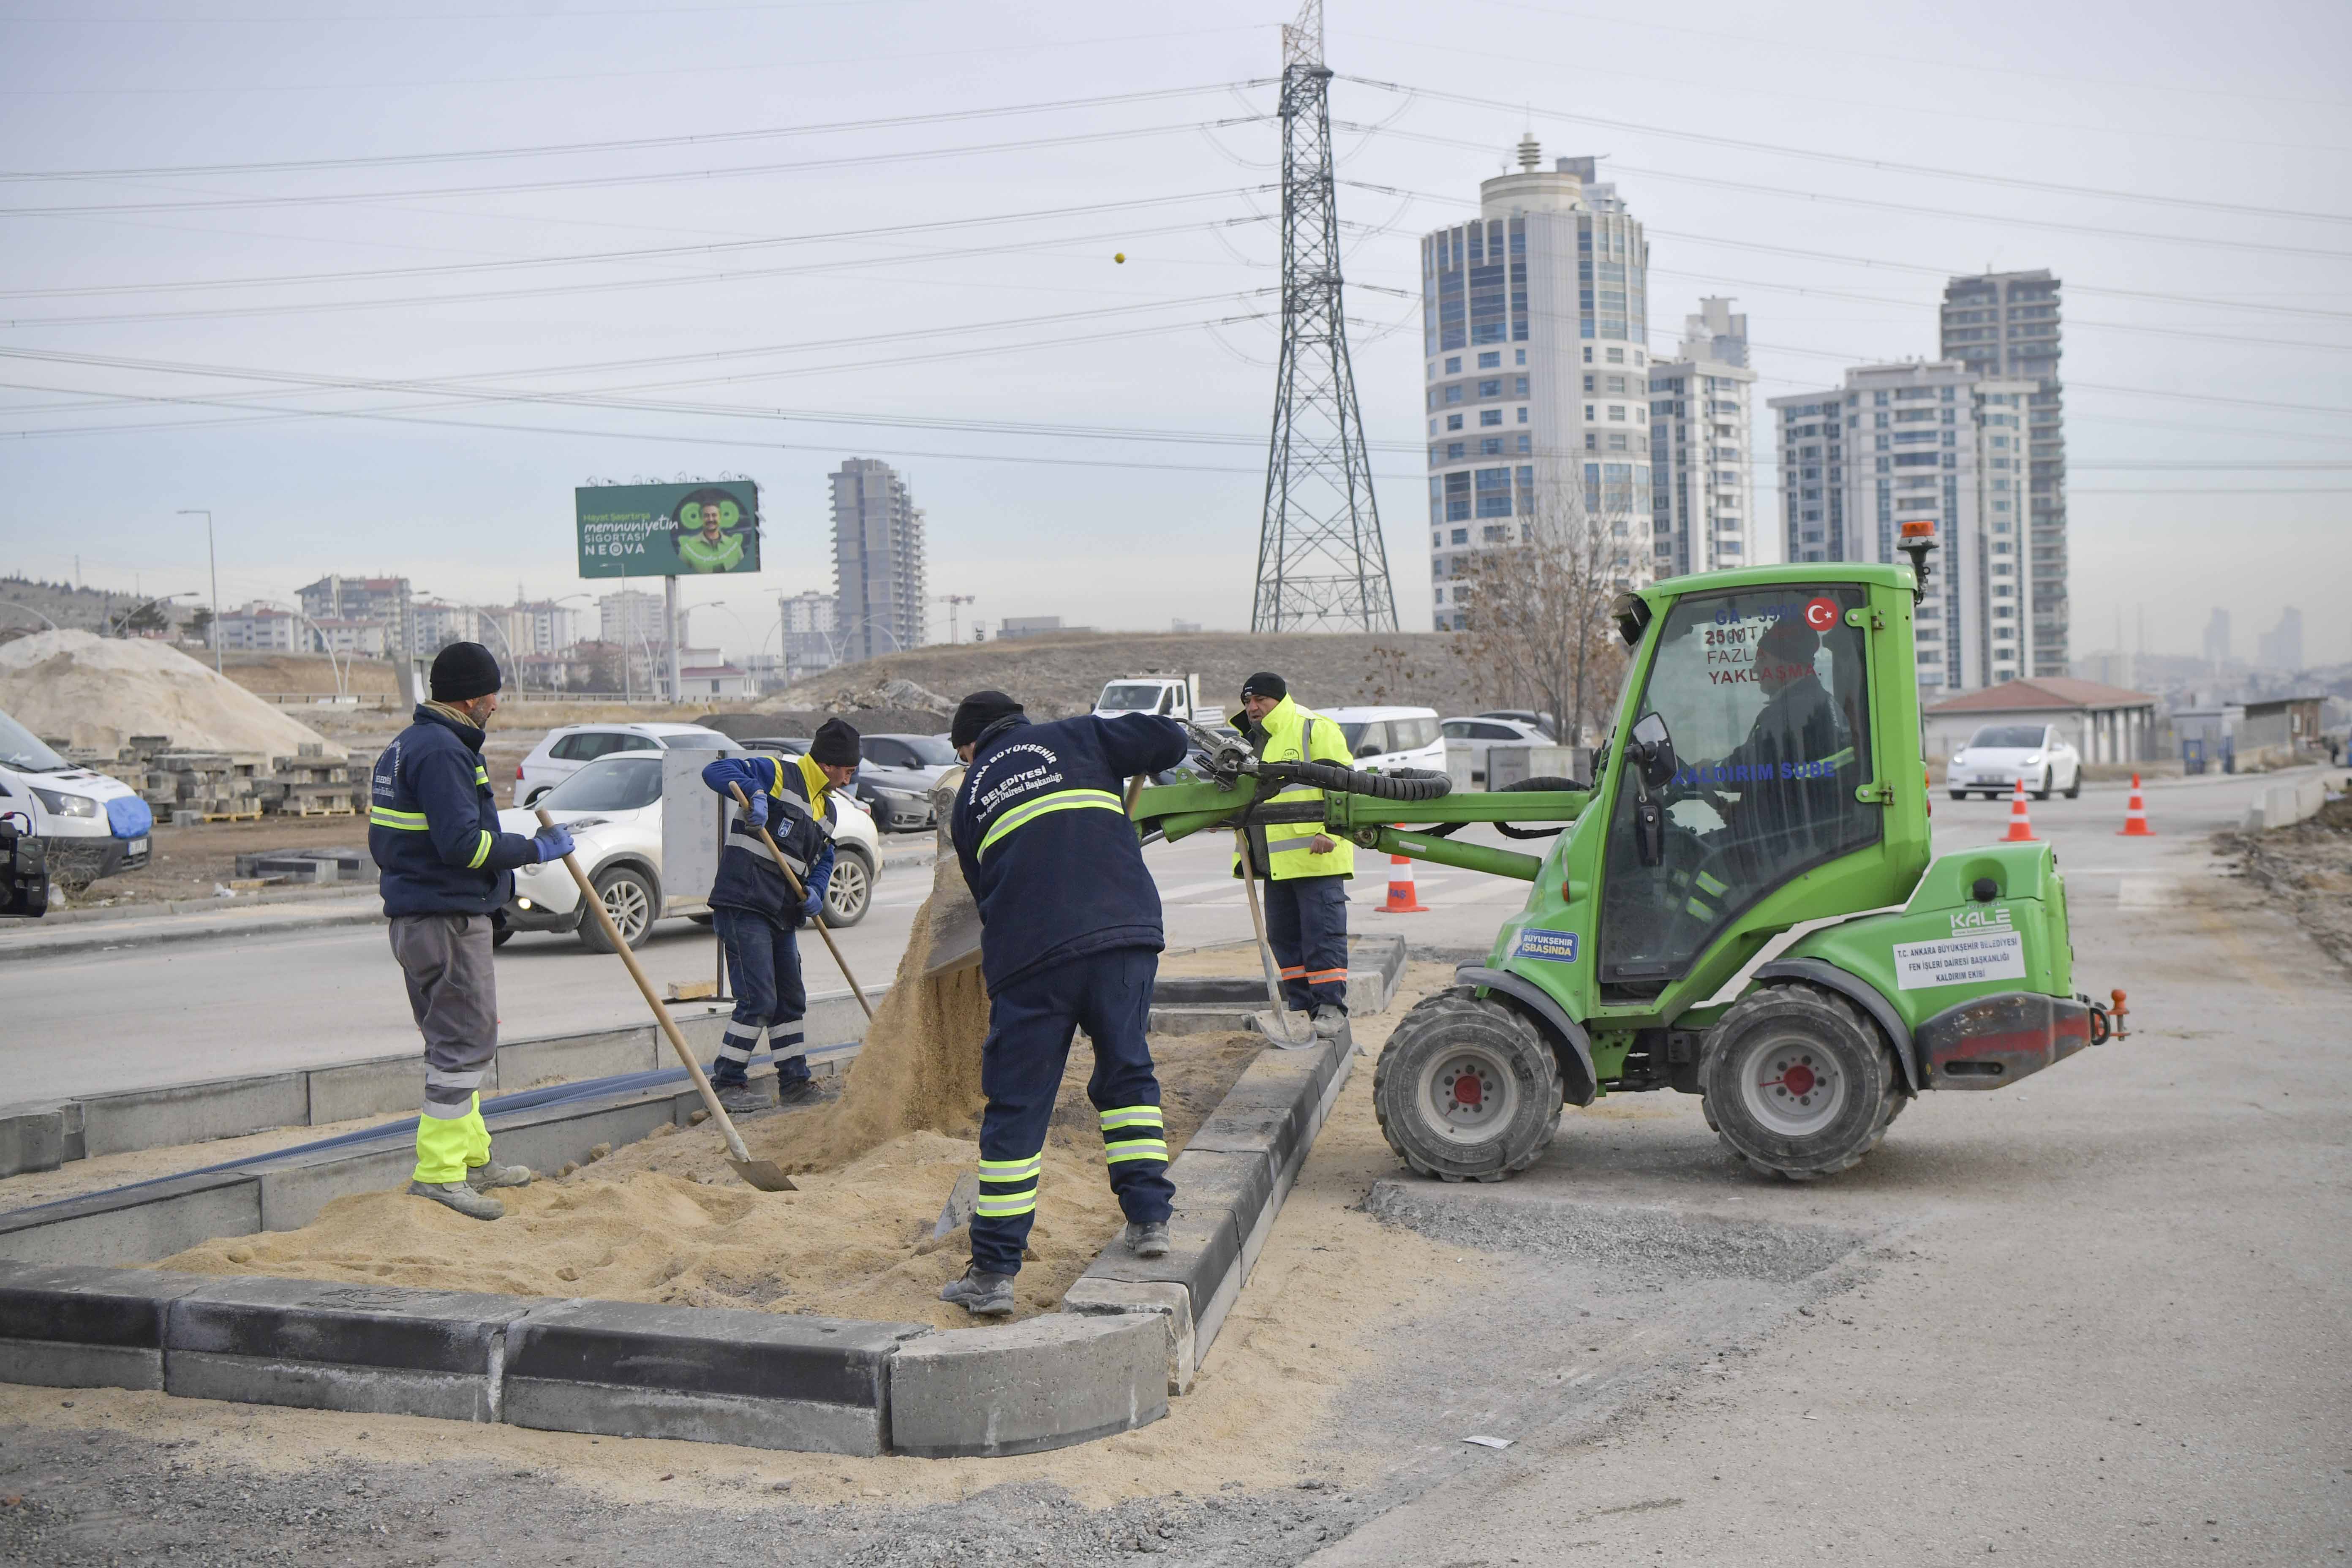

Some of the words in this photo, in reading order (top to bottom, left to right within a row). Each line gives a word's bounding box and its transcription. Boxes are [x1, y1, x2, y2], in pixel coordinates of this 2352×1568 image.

[584, 514, 678, 537] memnuniyetin
[585, 542, 645, 556] NEOVA
[1715, 609, 1741, 625] GA
[1707, 648, 1764, 664] FAZLA
[1671, 763, 1773, 785] KALDIRIM
[969, 765, 990, 805] ANKARA
[980, 765, 1047, 806] BELEDİYESİ
[1000, 783, 1025, 801] Dairesi
[1950, 909, 2011, 928] KALE
[1910, 947, 1936, 957] ANKARA
[1908, 963, 1921, 971] FEN
[1936, 972, 1966, 982] KALDIRIM
